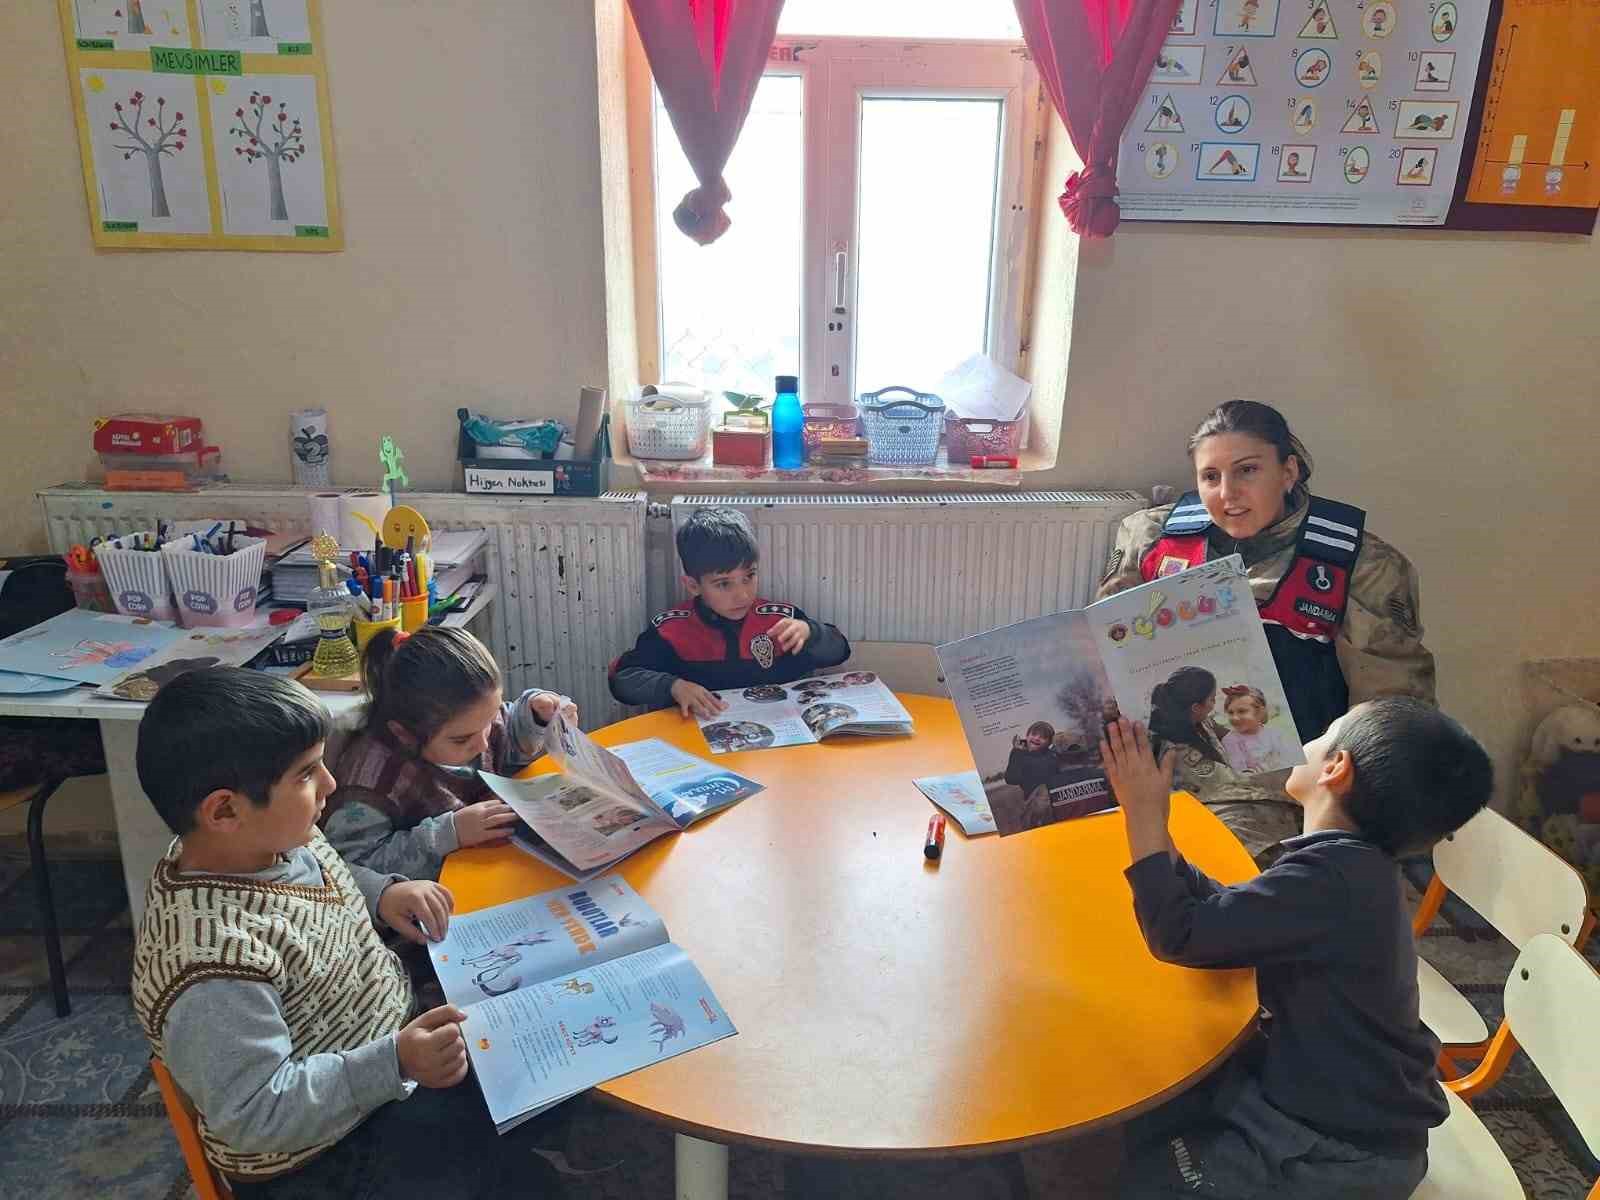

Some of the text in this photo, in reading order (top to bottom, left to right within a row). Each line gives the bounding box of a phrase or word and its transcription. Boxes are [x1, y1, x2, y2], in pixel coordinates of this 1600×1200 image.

[1428, 3, 1436, 13] 5
[1226, 46, 1233, 56] 7
[1291, 48, 1298, 58] 8
[1355, 49, 1361, 59] 9
[1408, 52, 1418, 62] 10
[1151, 94, 1159, 105] 11
[1209, 96, 1219, 106] 12
[1287, 97, 1296, 108] 13
[1388, 100, 1399, 111] 15
[1136, 143, 1146, 152] 16
[1190, 143, 1200, 153] 17
[1271, 146, 1280, 156] 18
[1389, 149, 1400, 159] 20
